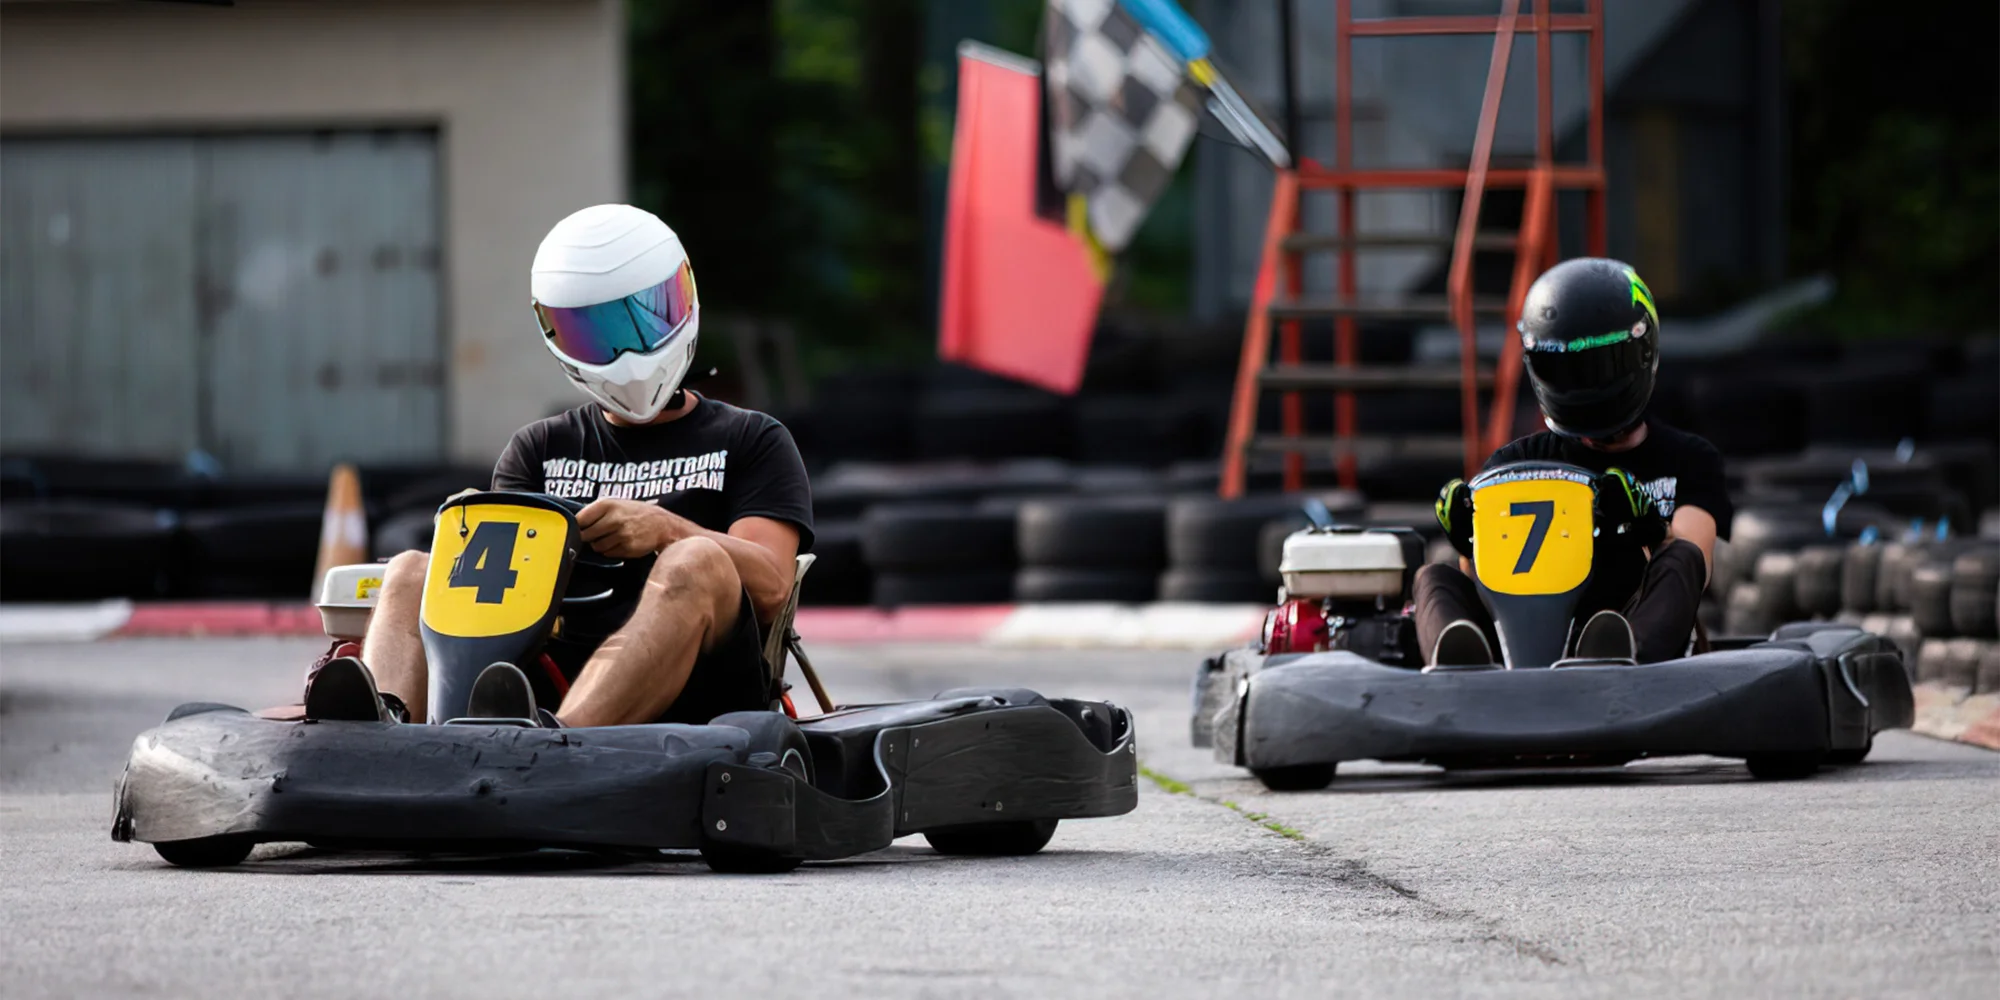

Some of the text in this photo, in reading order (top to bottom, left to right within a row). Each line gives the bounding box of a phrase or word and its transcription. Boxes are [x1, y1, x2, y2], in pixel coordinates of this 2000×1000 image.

[543, 450, 728, 482] MOTOKARCENTRUM
[544, 479, 595, 498] CZECH
[675, 471, 725, 492] TEAM
[449, 521, 520, 604] 4
[1510, 500, 1554, 575] 7
